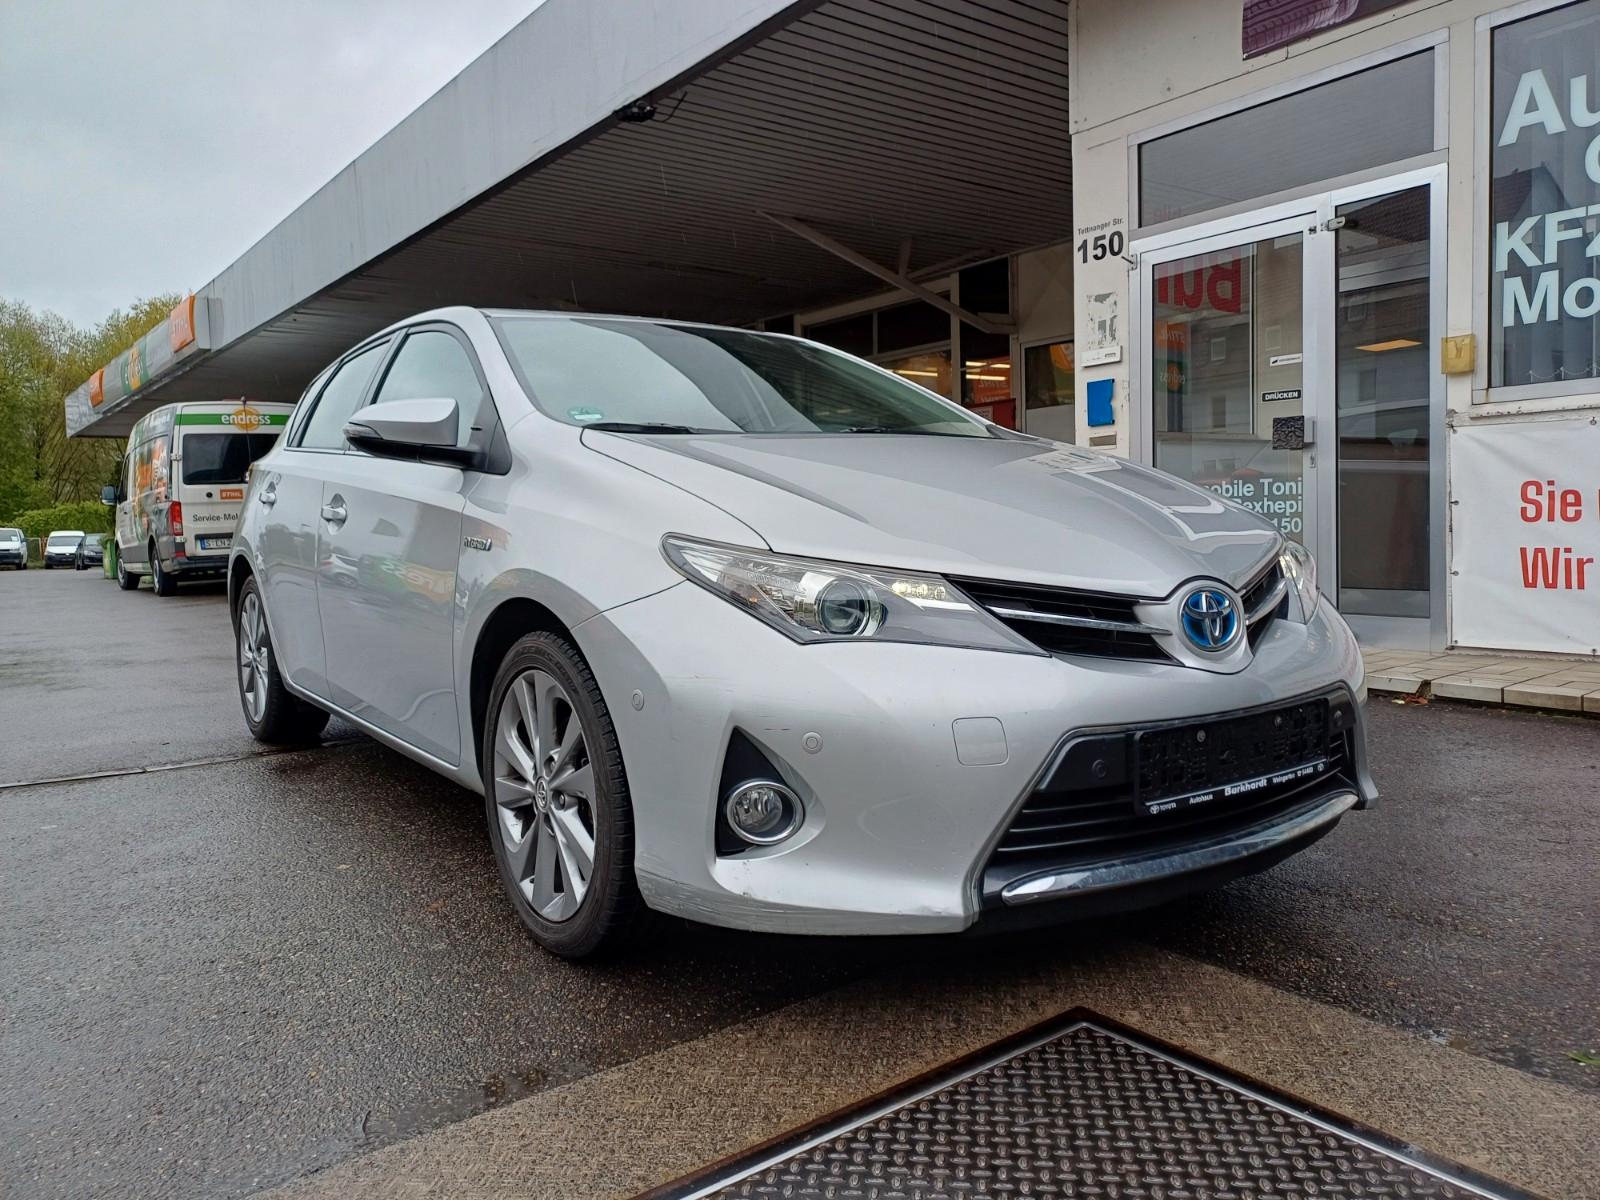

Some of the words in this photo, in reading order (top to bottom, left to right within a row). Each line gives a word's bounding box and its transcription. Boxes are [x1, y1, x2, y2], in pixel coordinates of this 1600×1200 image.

[1077, 230, 1124, 264] 150
[1503, 269, 1600, 328] Mo
[1265, 391, 1299, 401] DRÜCKEN
[221, 411, 271, 425] endress
[1259, 477, 1303, 496] Toni
[1520, 480, 1582, 523] Sie
[1519, 547, 1594, 591] Wir
[1224, 778, 1268, 796] Burkhardt
